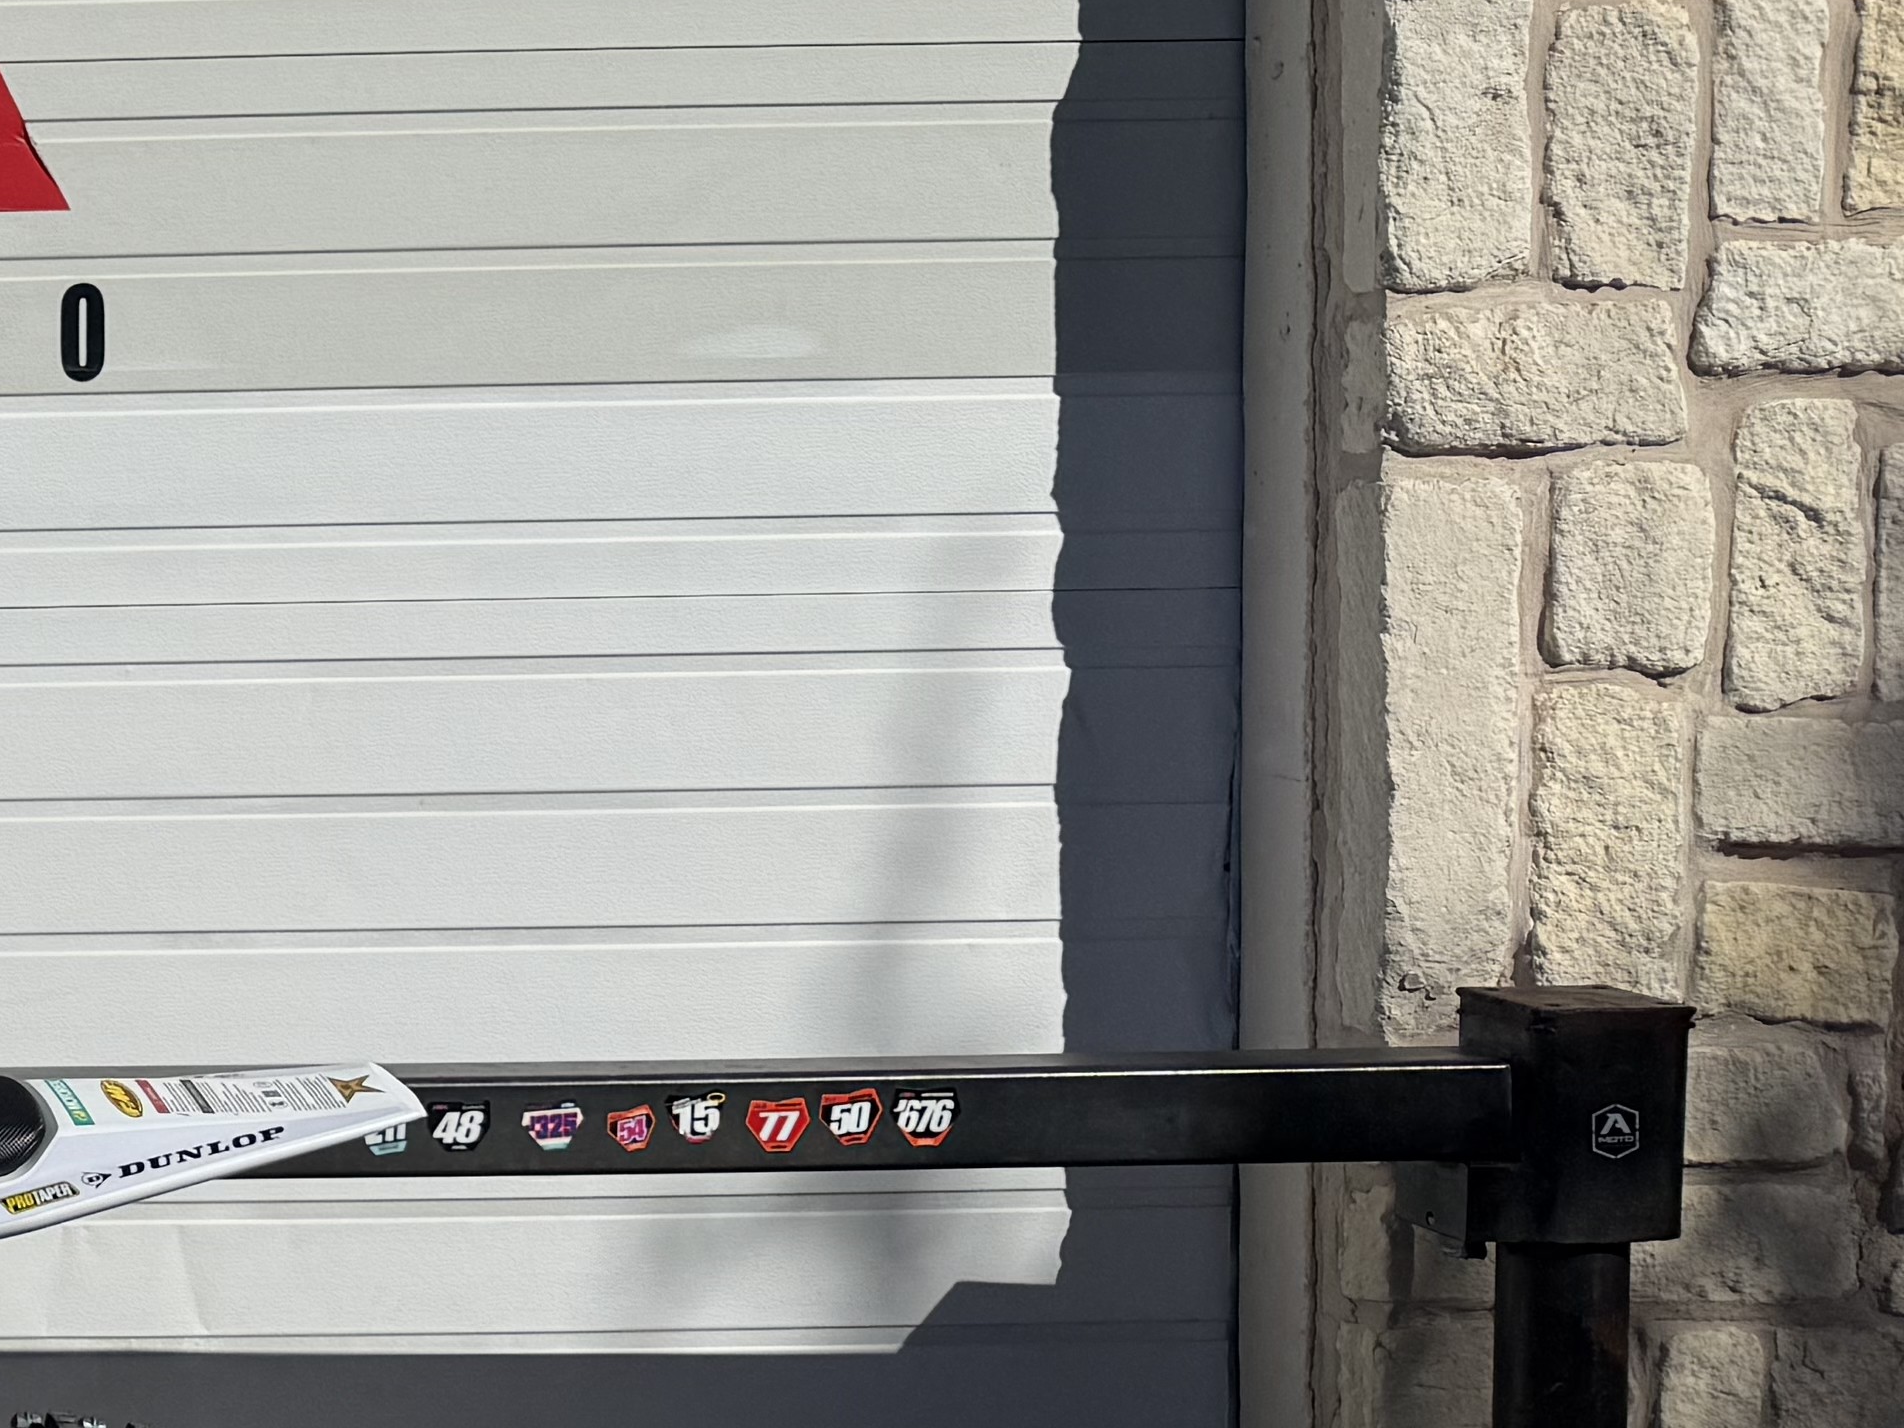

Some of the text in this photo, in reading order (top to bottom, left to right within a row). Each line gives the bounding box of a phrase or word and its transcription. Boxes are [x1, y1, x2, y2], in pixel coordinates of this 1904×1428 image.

[432, 1110, 485, 1144] 48
[617, 1115, 647, 1144] 54
[672, 1101, 721, 1136] 15
[758, 1110, 800, 1142] 77
[830, 1101, 871, 1135] 50
[118, 1125, 285, 1178] DUNLOP
[5, 1182, 74, 1213] PROTAPER
